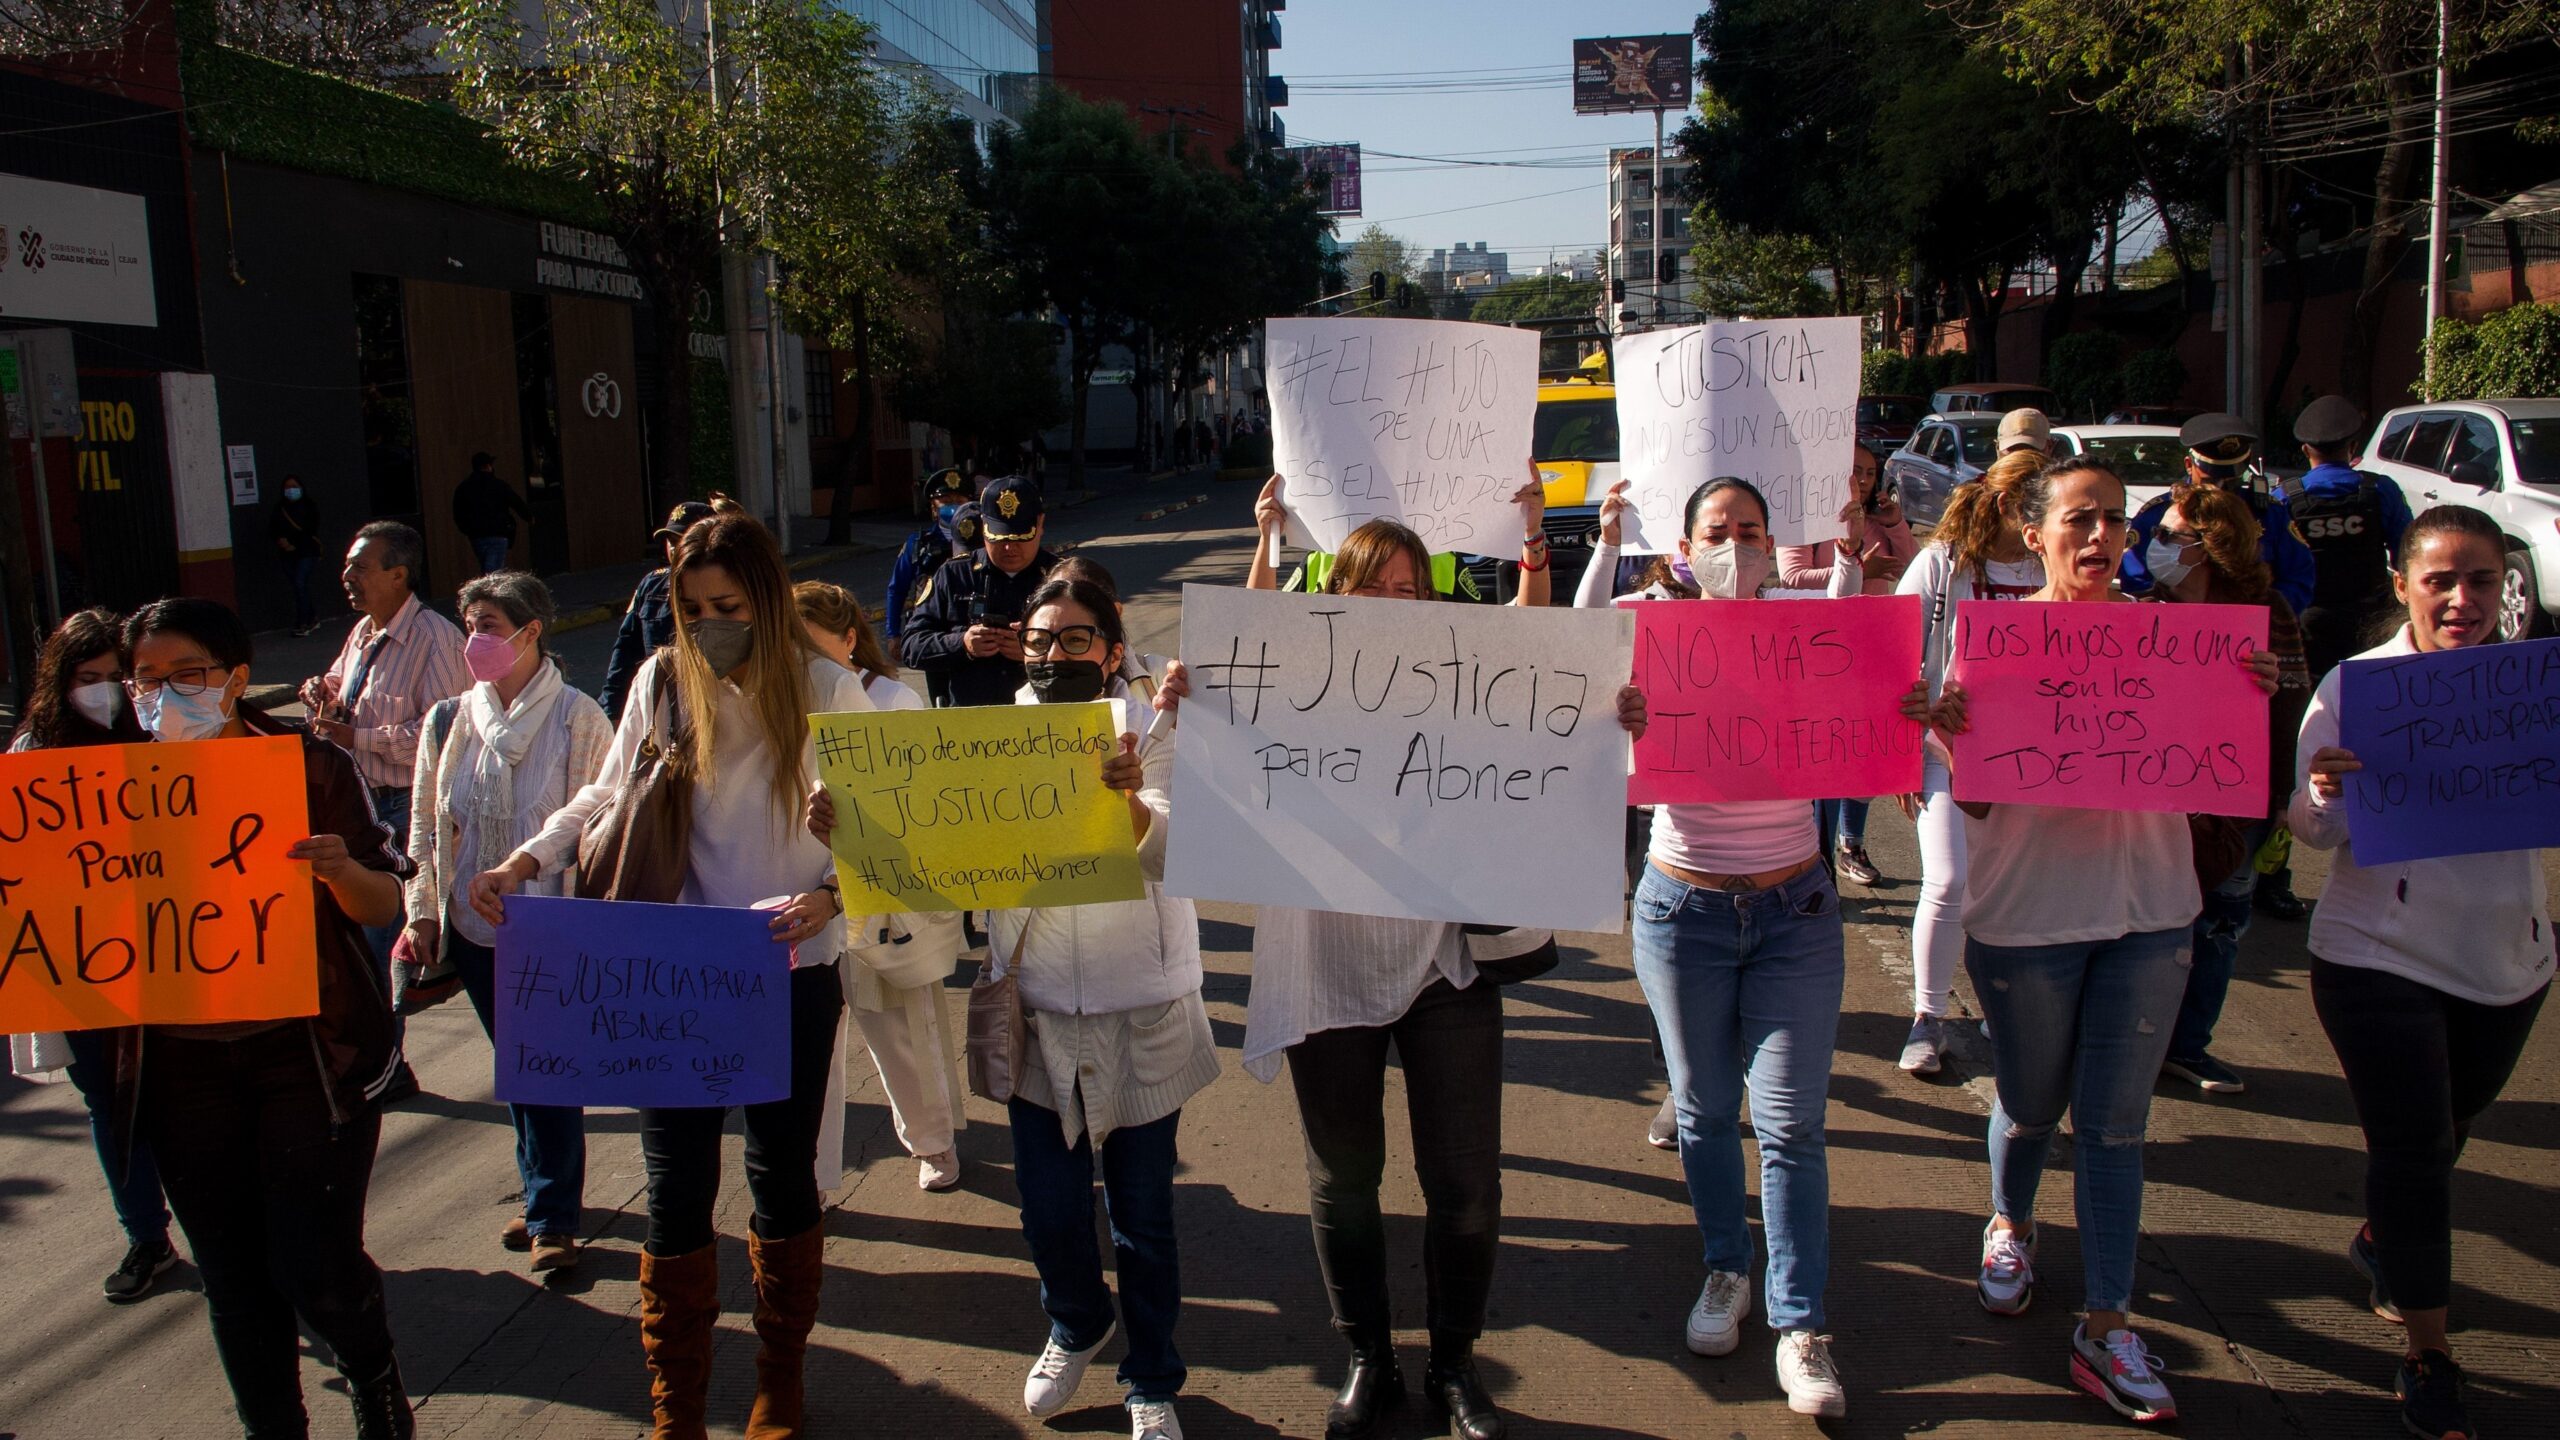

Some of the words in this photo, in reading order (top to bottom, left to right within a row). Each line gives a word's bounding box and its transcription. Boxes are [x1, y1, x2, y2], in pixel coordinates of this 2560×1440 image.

[50, 243, 86, 254] GOBIERNO
[88, 247, 97, 255] DE
[99, 249, 109, 257] LA
[50, 253, 75, 263] CIUDAD
[76, 256, 85, 264] DE
[86, 255, 110, 266] MÉXICO
[118, 255, 138, 265] CEJUR
[536, 256, 575, 289] PARA
[575, 266, 643, 300] MASCOTAS
[1278, 335, 1383, 413] #EL
[1397, 340, 1498, 412] HIJO
[1656, 328, 1824, 408] JUSTICIA
[73, 400, 136, 442] TRO
[1370, 411, 1411, 442] DE
[1426, 417, 1495, 463] UNA
[1641, 419, 1671, 466] NO
[1683, 415, 1716, 456] ES
[1721, 414, 1760, 454] UN
[1286, 459, 1334, 497] ES
[1342, 464, 1389, 499] EL
[1396, 471, 1464, 512] HIJO
[1468, 474, 1512, 503] DE
[1322, 513, 1473, 546] TDAS
[2307, 514, 2365, 538] SSC
[1646, 624, 1719, 695] NO
[1751, 624, 1853, 682] MÁS
[2044, 609, 2123, 675] hijos
[2137, 614, 2186, 665] de
[2195, 629, 2256, 666] una
[2035, 677, 2102, 698] son
[2113, 668, 2155, 699] los
[2054, 700, 2147, 750] hijos
[881, 727, 926, 781] hijo
[1255, 742, 1361, 809] para
[1395, 732, 1569, 807] Abner
[1984, 746, 2084, 790] DE
[2356, 771, 2408, 813] NO
[2429, 758, 2560, 806] INDIFER
[67, 840, 164, 889] Para
[0, 892, 285, 990] Abner
[591, 1004, 710, 1044] ABNER
